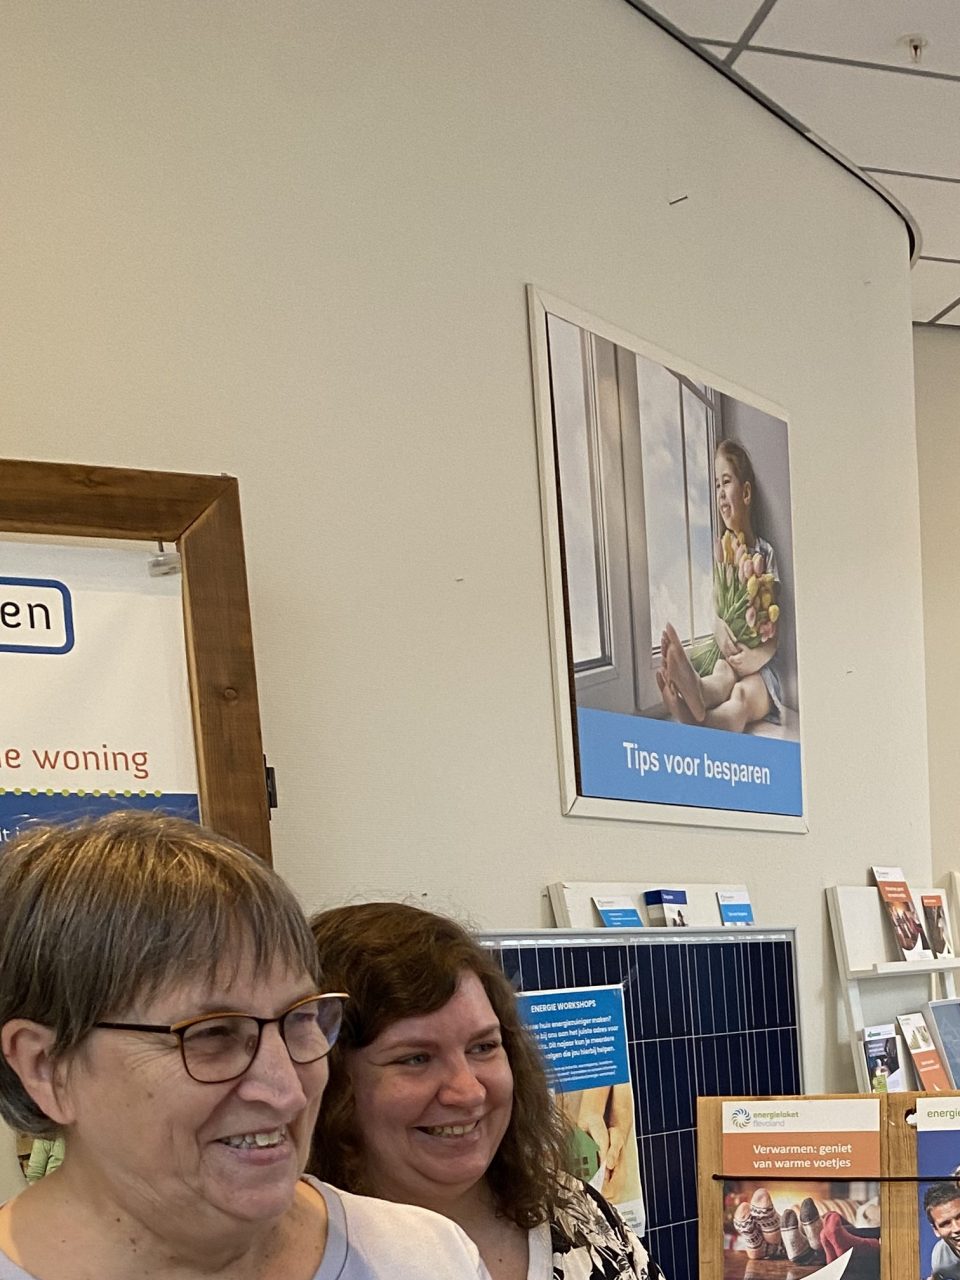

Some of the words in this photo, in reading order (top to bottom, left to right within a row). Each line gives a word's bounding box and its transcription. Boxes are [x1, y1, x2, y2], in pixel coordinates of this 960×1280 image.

[31, 743, 149, 779] woning
[622, 741, 659, 775] Tips
[663, 754, 700, 778] voor
[704, 751, 771, 785] besparen
[530, 1003, 556, 1013] ENERGIE
[557, 1000, 596, 1011] WORKSHOPS
[752, 1110, 799, 1120] energieloket
[752, 1119, 785, 1128] flevoland
[753, 1143, 818, 1155] Verwarmen:
[819, 1143, 852, 1156] geniet
[753, 1158, 773, 1168] van
[775, 1158, 811, 1168] warme
[813, 1156, 852, 1170] voetjes
